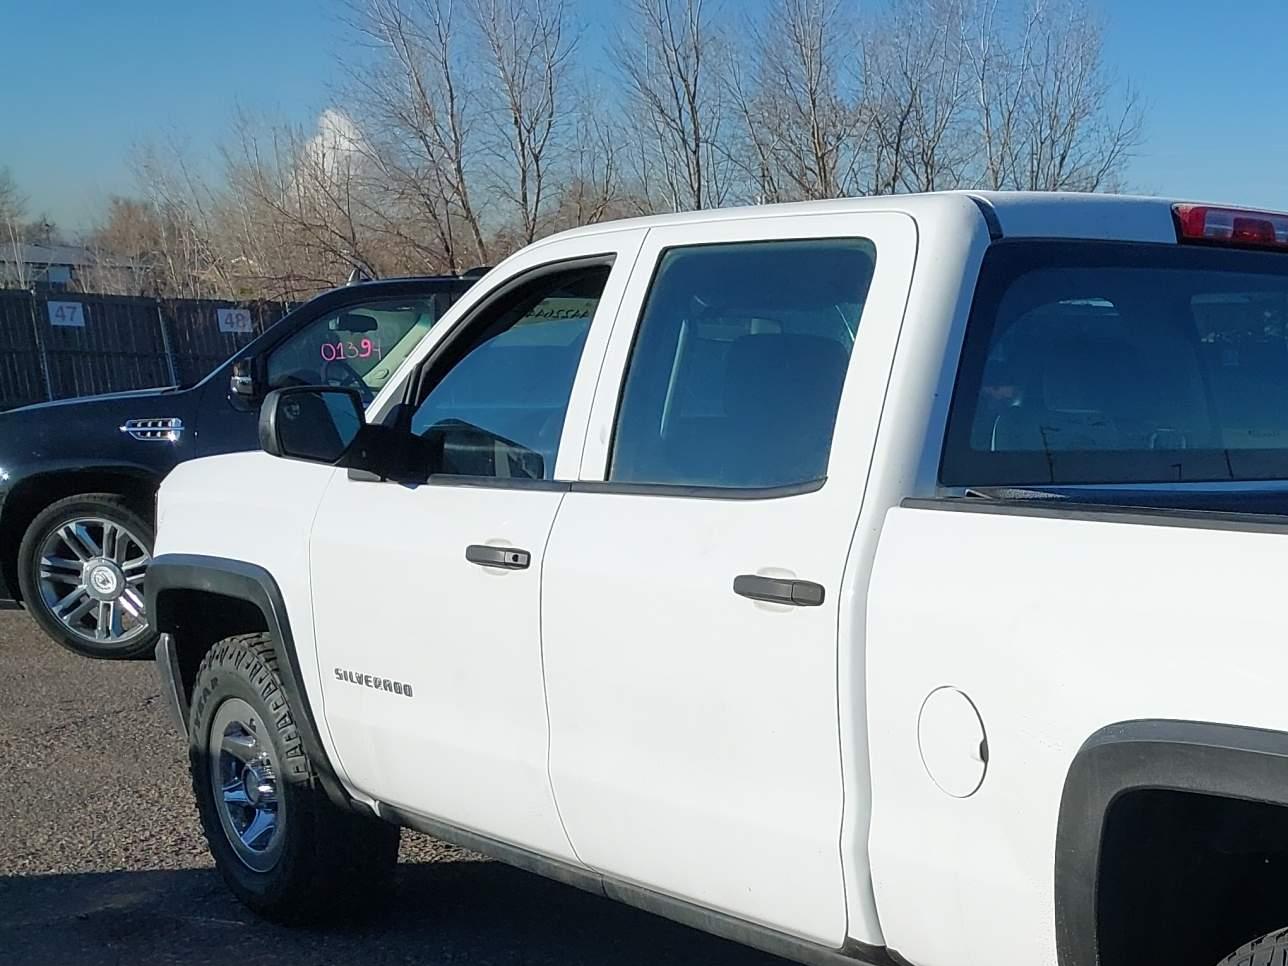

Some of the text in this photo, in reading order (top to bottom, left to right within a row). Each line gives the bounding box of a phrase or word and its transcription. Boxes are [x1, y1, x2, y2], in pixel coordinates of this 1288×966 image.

[55, 305, 77, 322] 47
[223, 312, 247, 329] 48
[334, 667, 414, 698] SILVERADO
